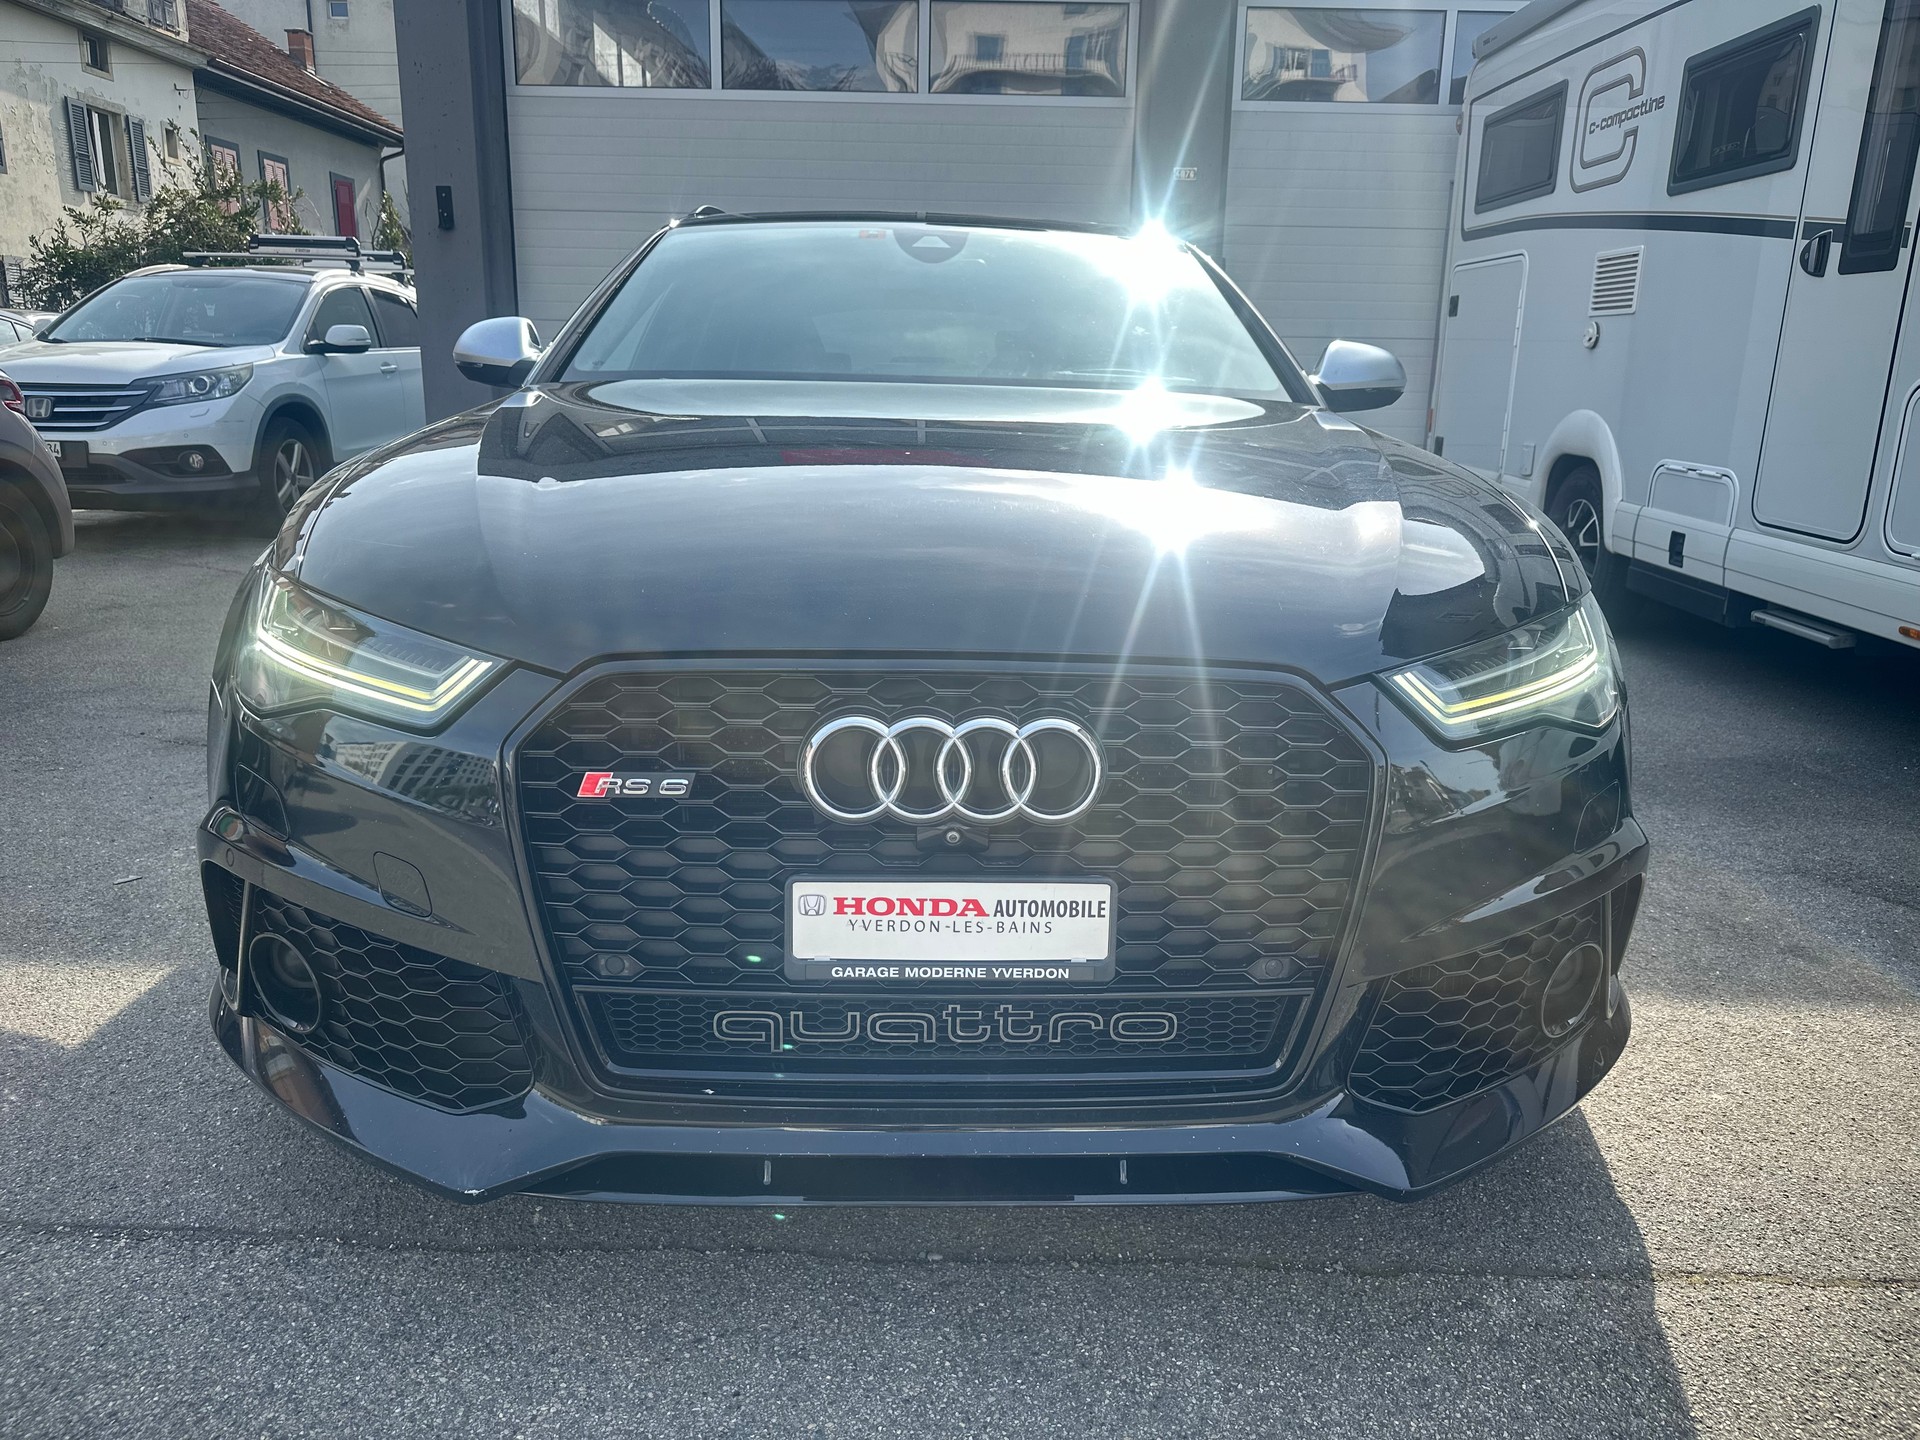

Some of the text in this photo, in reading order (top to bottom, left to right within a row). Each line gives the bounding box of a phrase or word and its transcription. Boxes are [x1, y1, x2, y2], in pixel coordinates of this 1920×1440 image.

[833, 896, 1106, 918] HONDA AUTOMOBILE
[849, 919, 1052, 934] YVERDON-LES-BAINS
[831, 966, 1070, 979] GARAGE MODERNE YVERDON
[713, 1005, 1178, 1053] quattro
